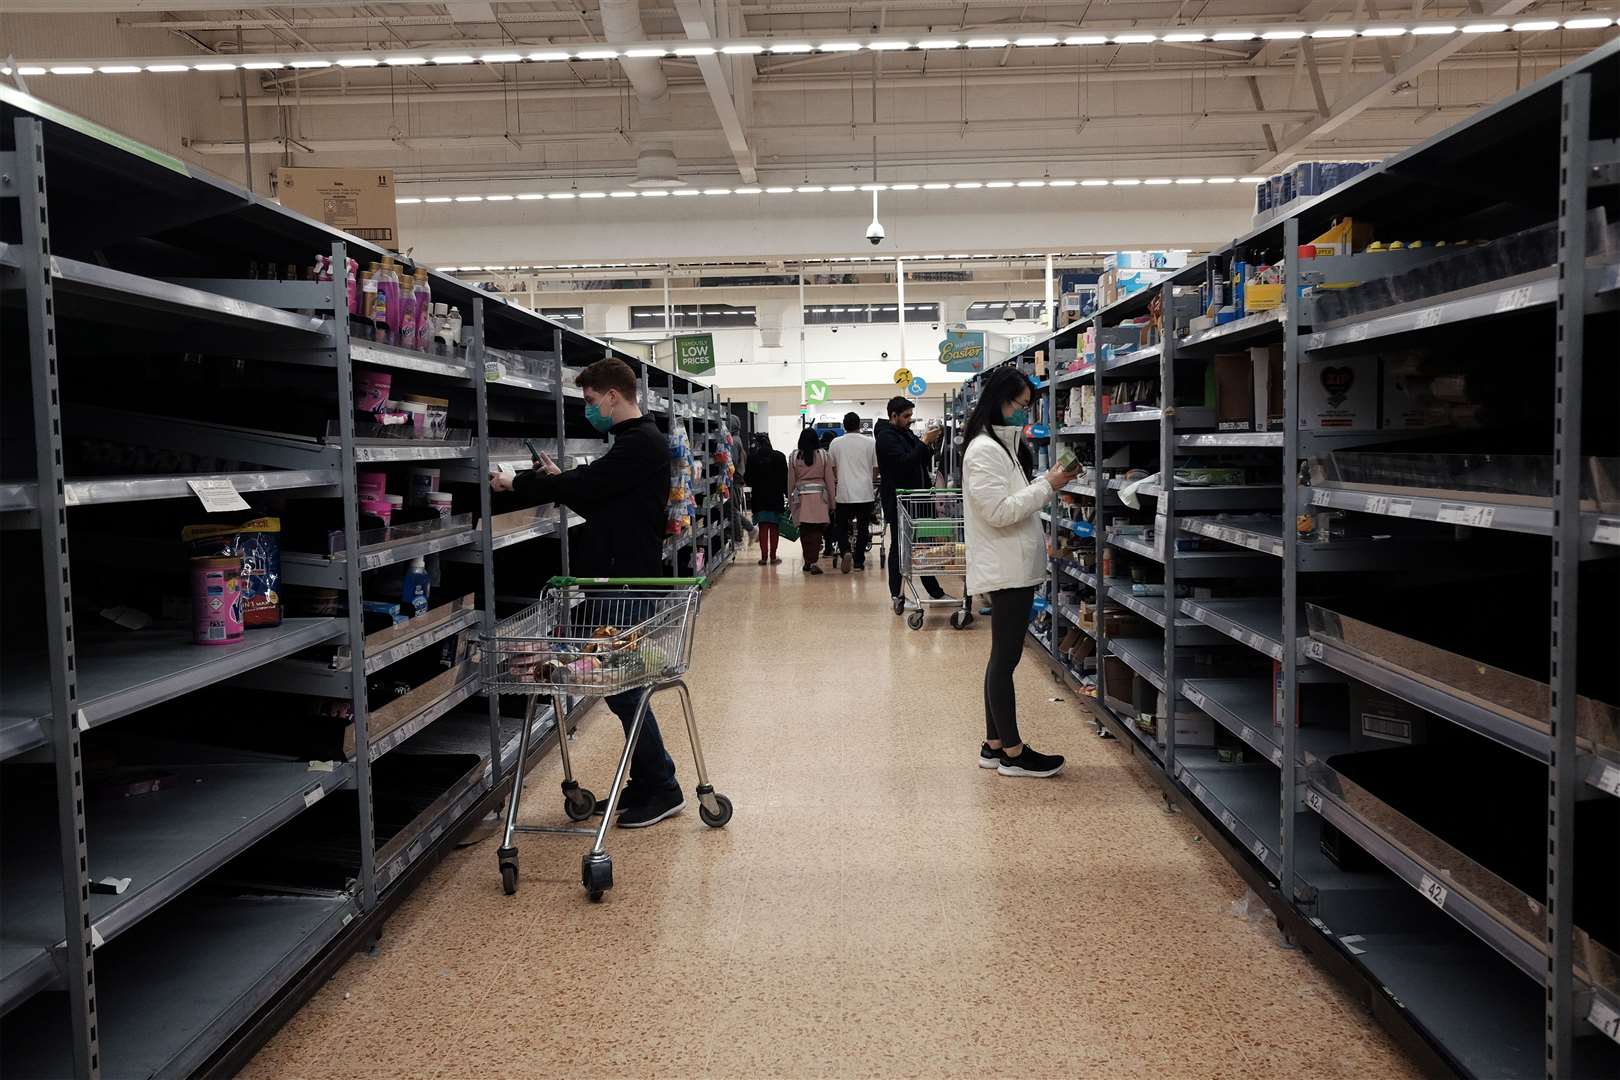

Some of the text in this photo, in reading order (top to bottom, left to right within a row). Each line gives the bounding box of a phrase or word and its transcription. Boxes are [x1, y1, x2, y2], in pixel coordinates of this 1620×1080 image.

[682, 346, 708, 357] LOW
[941, 342, 983, 363] Easter
[682, 356, 710, 366] PRICES
